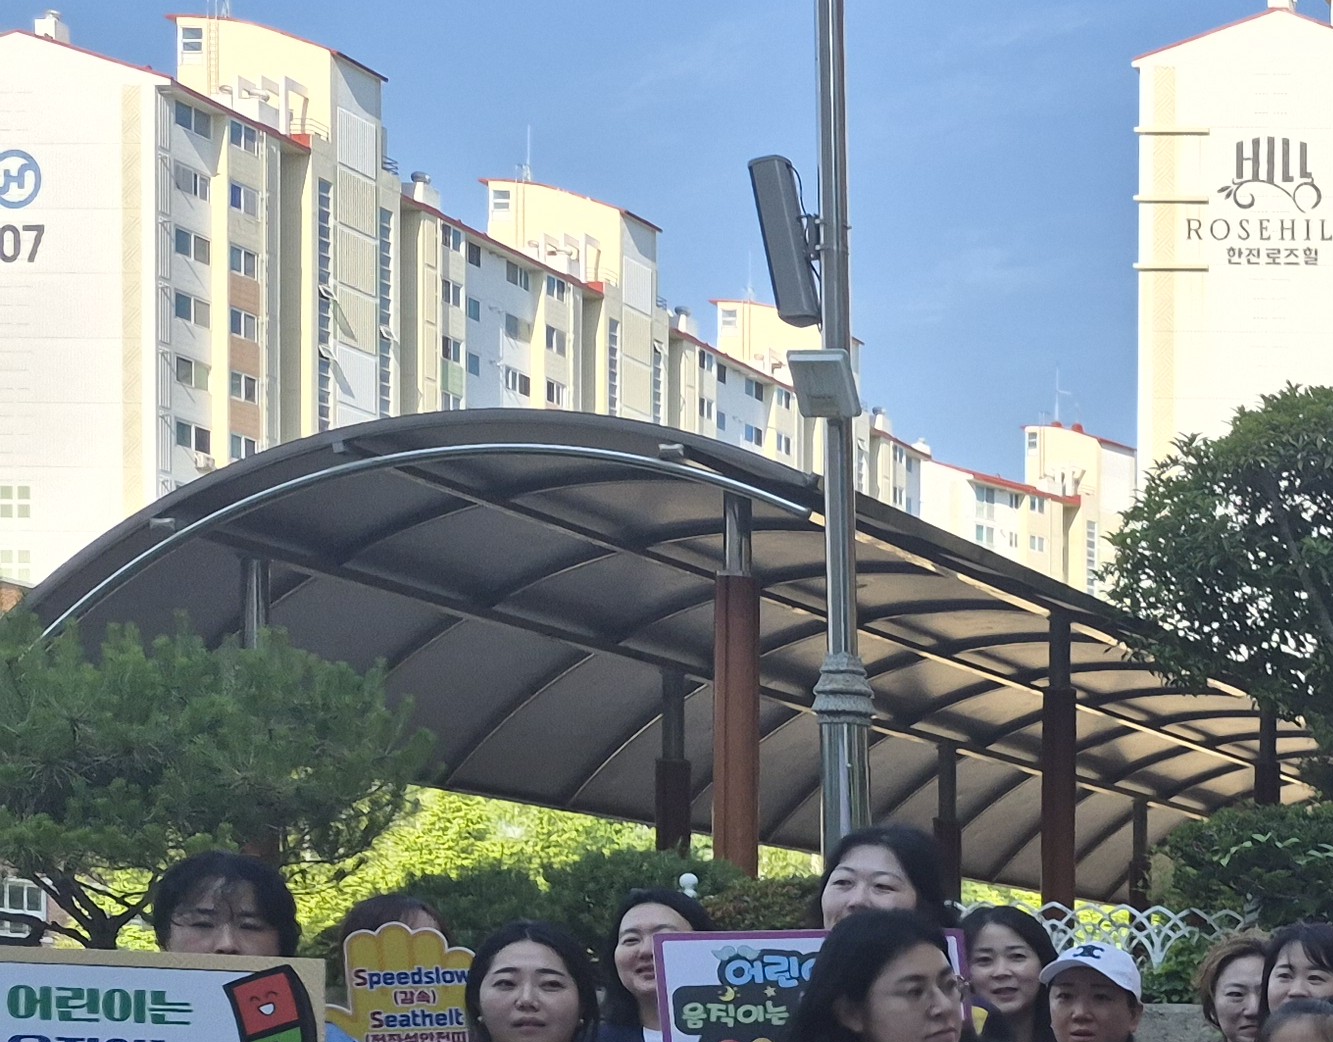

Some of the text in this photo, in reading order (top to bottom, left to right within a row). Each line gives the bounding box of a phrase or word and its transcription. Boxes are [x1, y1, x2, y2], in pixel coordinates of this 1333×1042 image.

[1226, 246, 1319, 266] 한진로즈힐
[353, 967, 469, 990] Speedslow
[7, 984, 194, 1026] 어린이는
[393, 989, 437, 1005] (감속)
[682, 1000, 790, 1029] 움직이는
